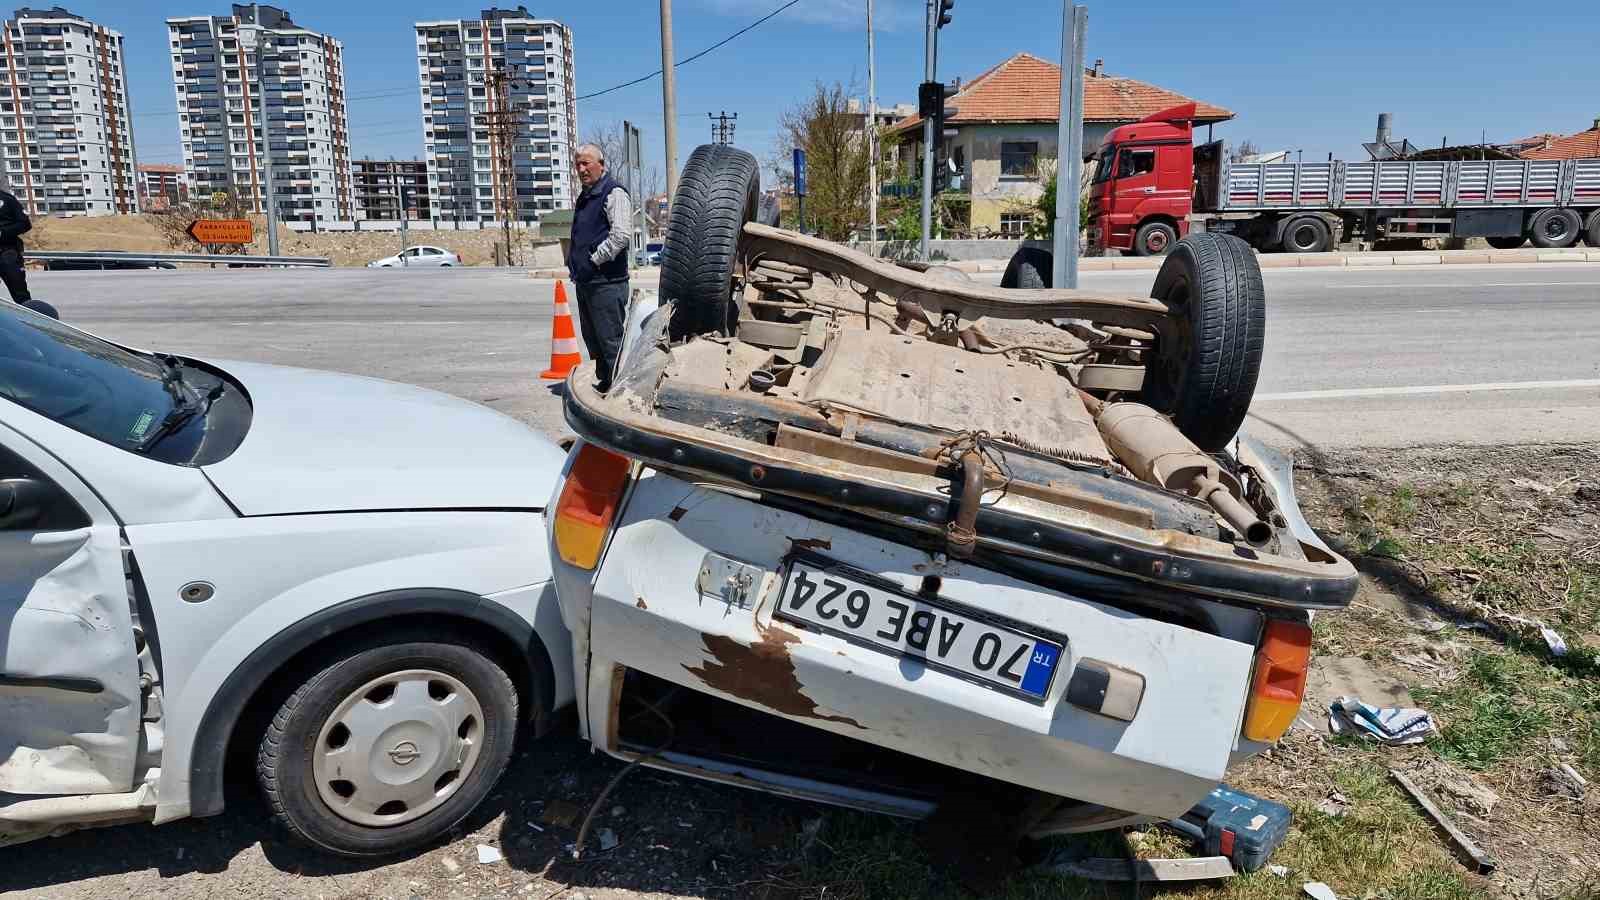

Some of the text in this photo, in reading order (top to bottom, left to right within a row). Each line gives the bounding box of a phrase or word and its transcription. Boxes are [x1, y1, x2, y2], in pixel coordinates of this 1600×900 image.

[790, 570, 1030, 683] 70 ABE 624
[1032, 650, 1051, 667] TR
